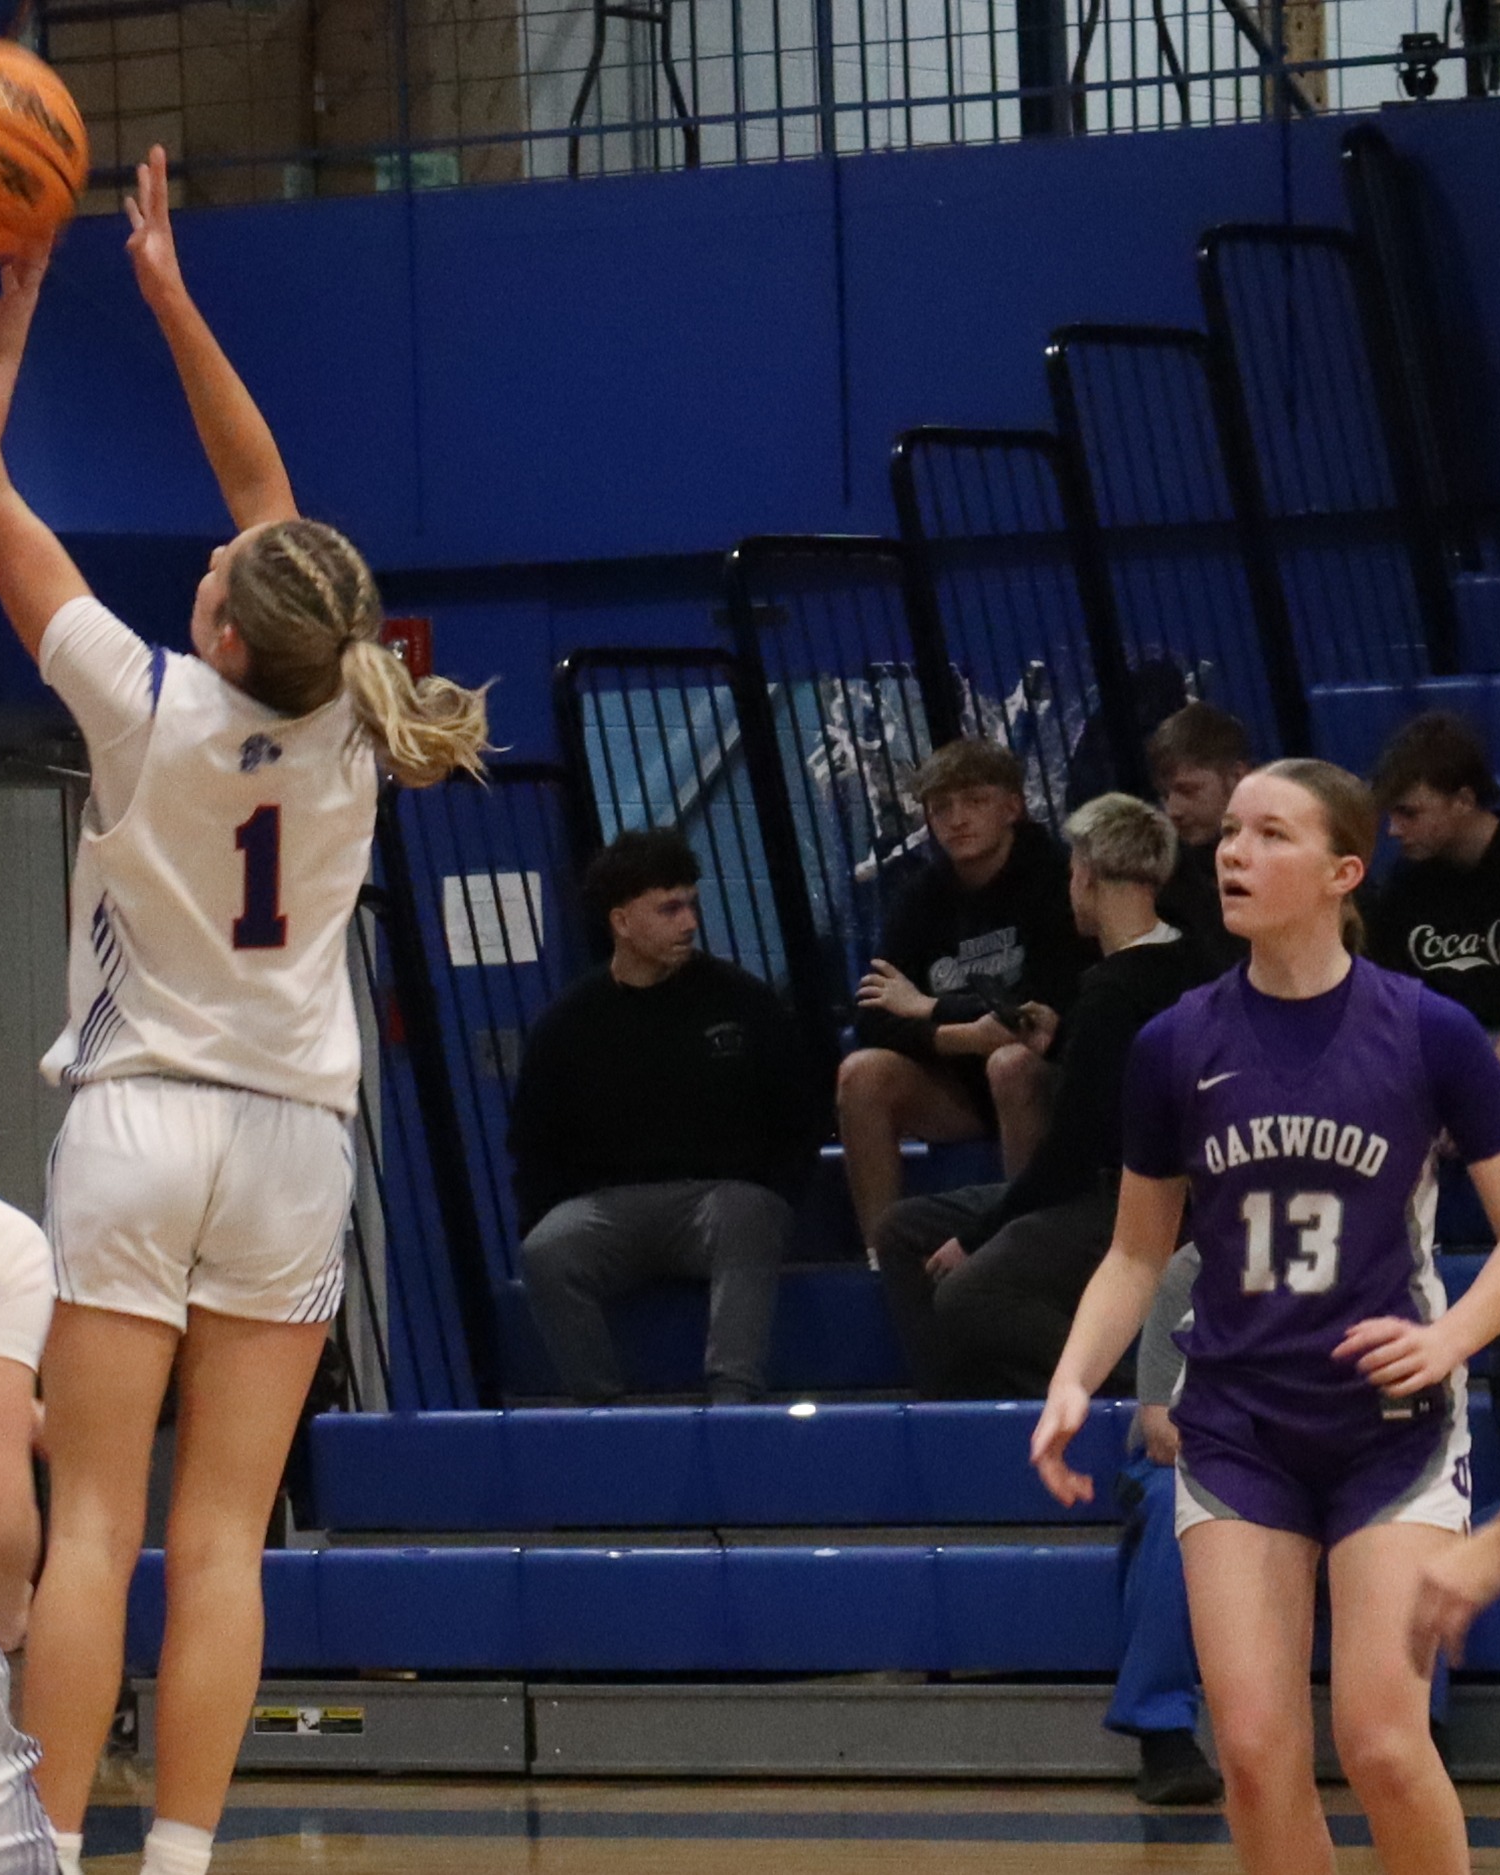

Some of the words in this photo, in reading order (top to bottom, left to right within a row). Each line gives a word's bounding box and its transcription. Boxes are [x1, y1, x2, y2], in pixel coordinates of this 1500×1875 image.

[233, 805, 287, 949] 1
[1205, 1115, 1389, 1178] OAKWOOD
[1242, 1191, 1344, 1294] 13
